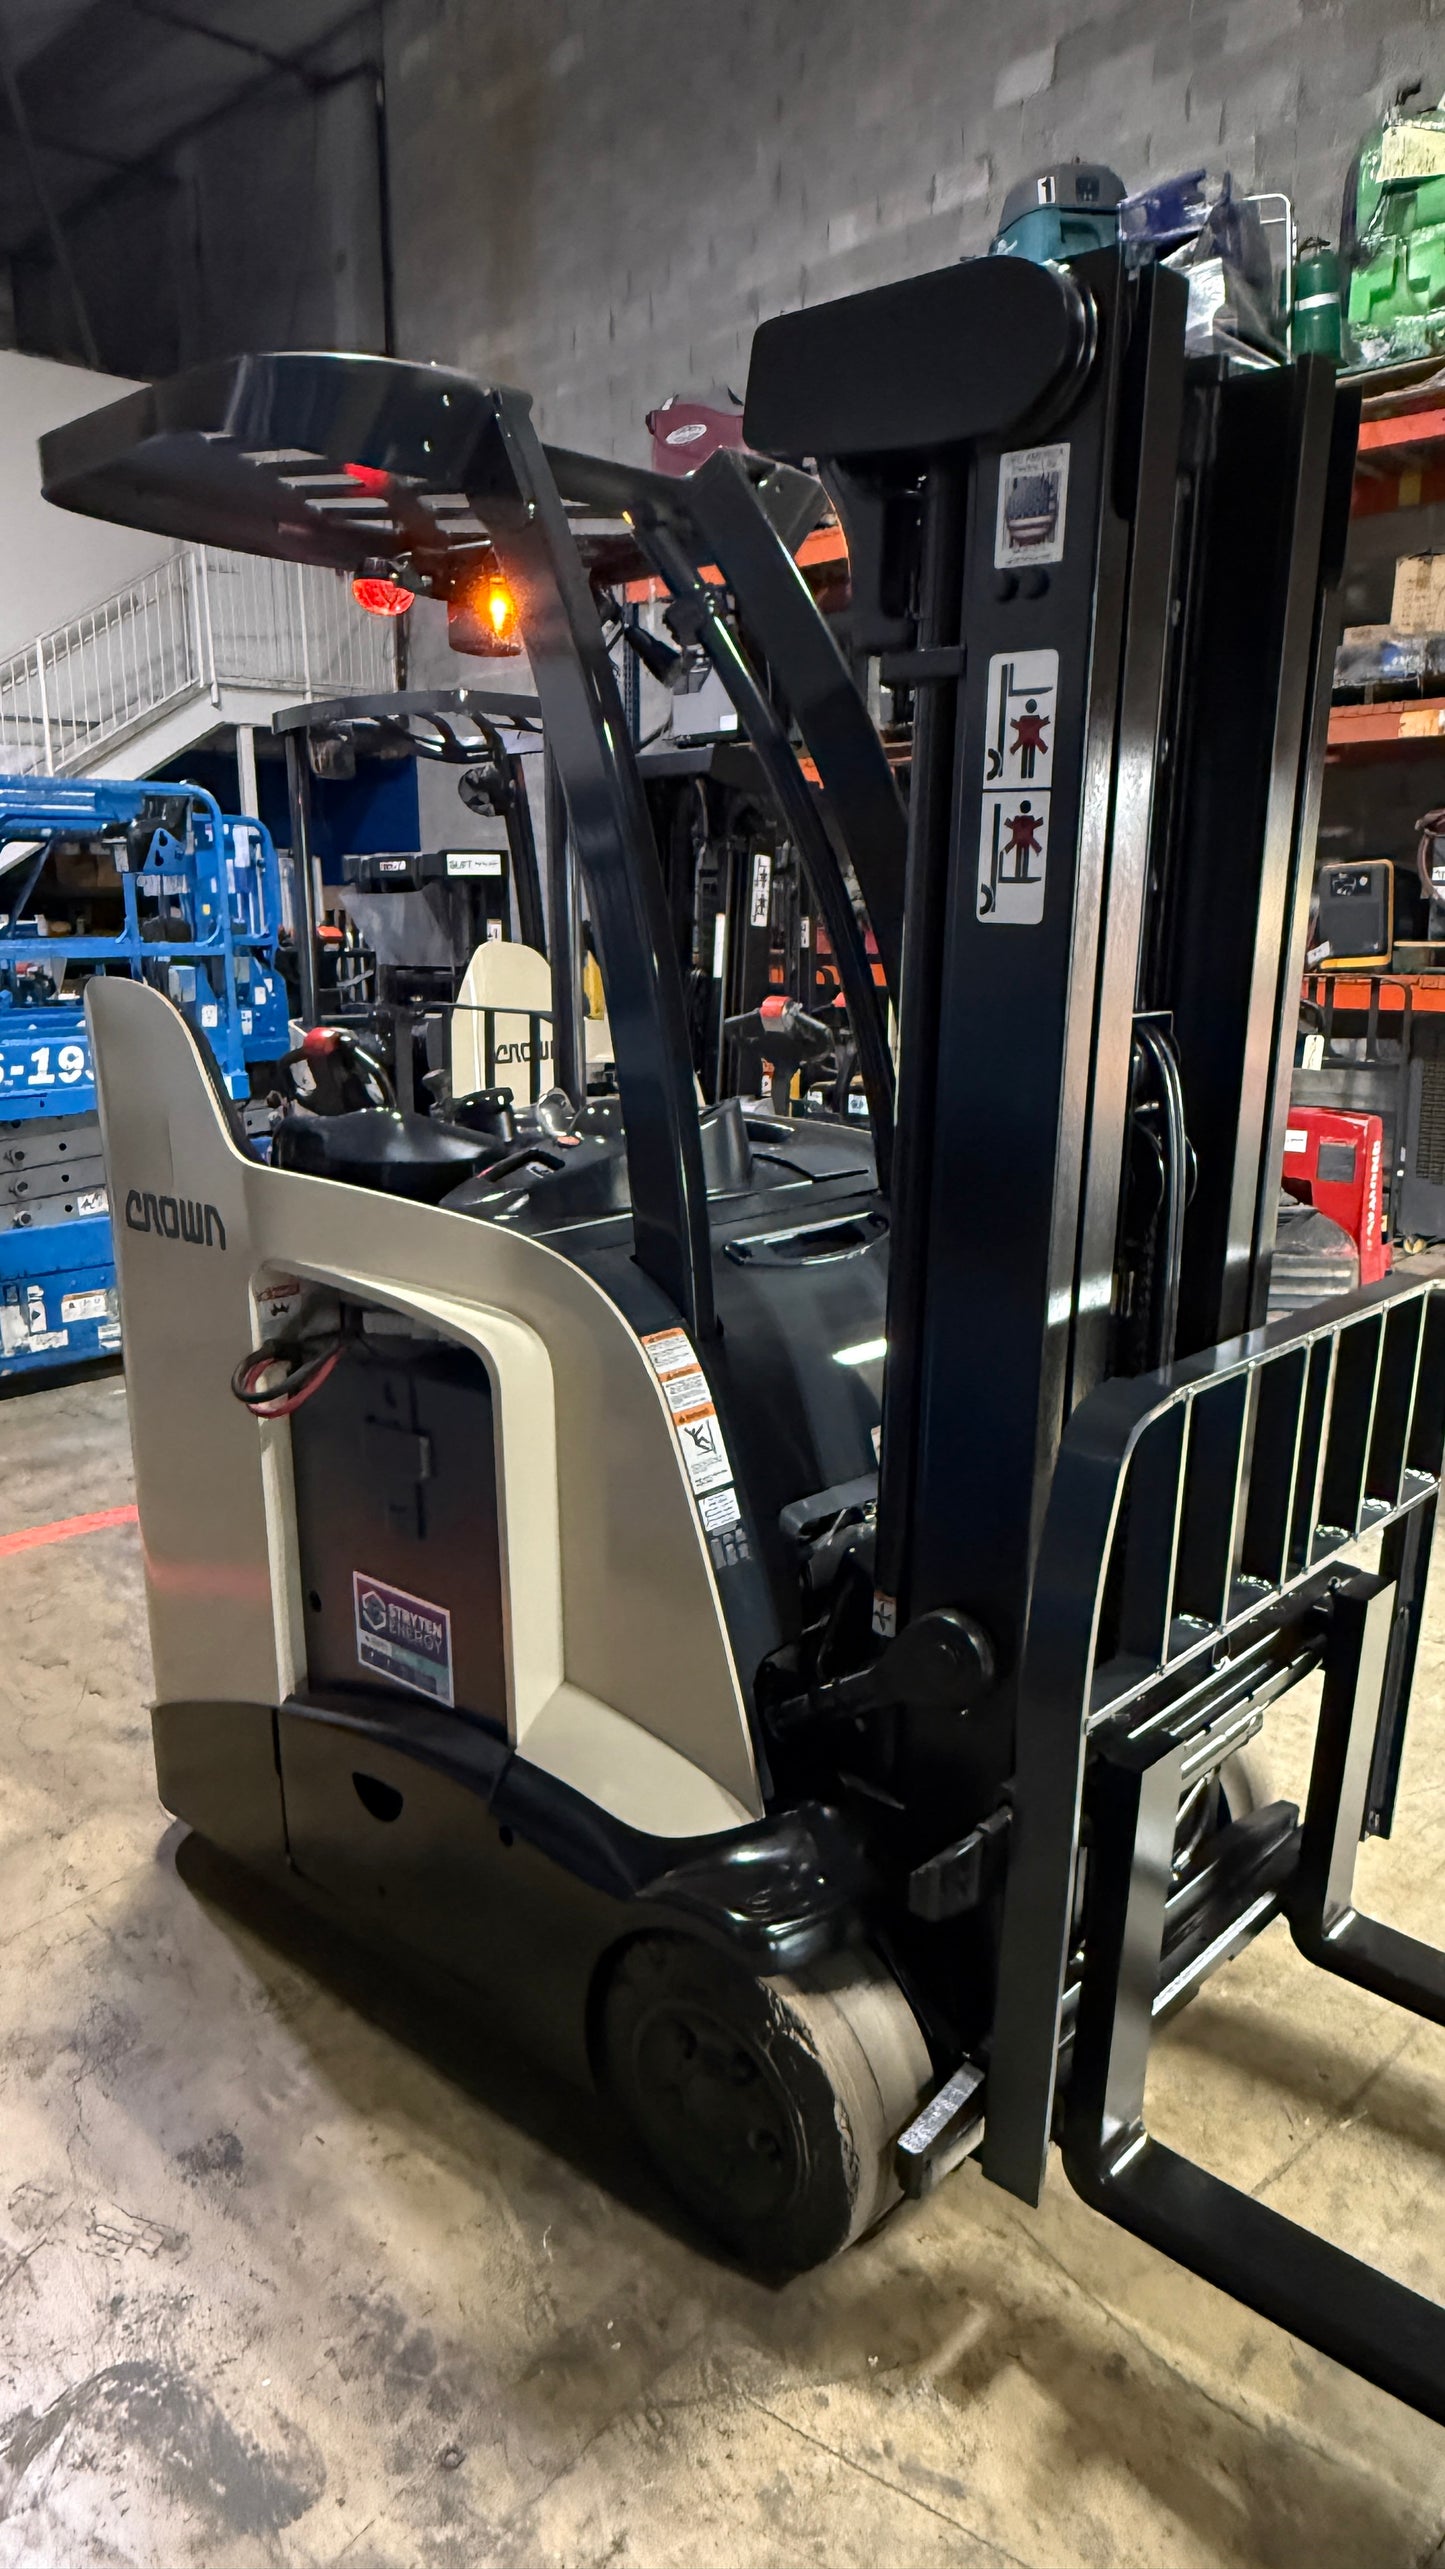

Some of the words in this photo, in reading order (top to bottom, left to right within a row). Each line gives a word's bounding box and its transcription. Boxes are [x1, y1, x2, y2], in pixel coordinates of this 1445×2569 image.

[1041, 176, 1053, 203] 1
[0, 1045, 95, 1086] -19
[126, 1189, 226, 1251] CROWN
